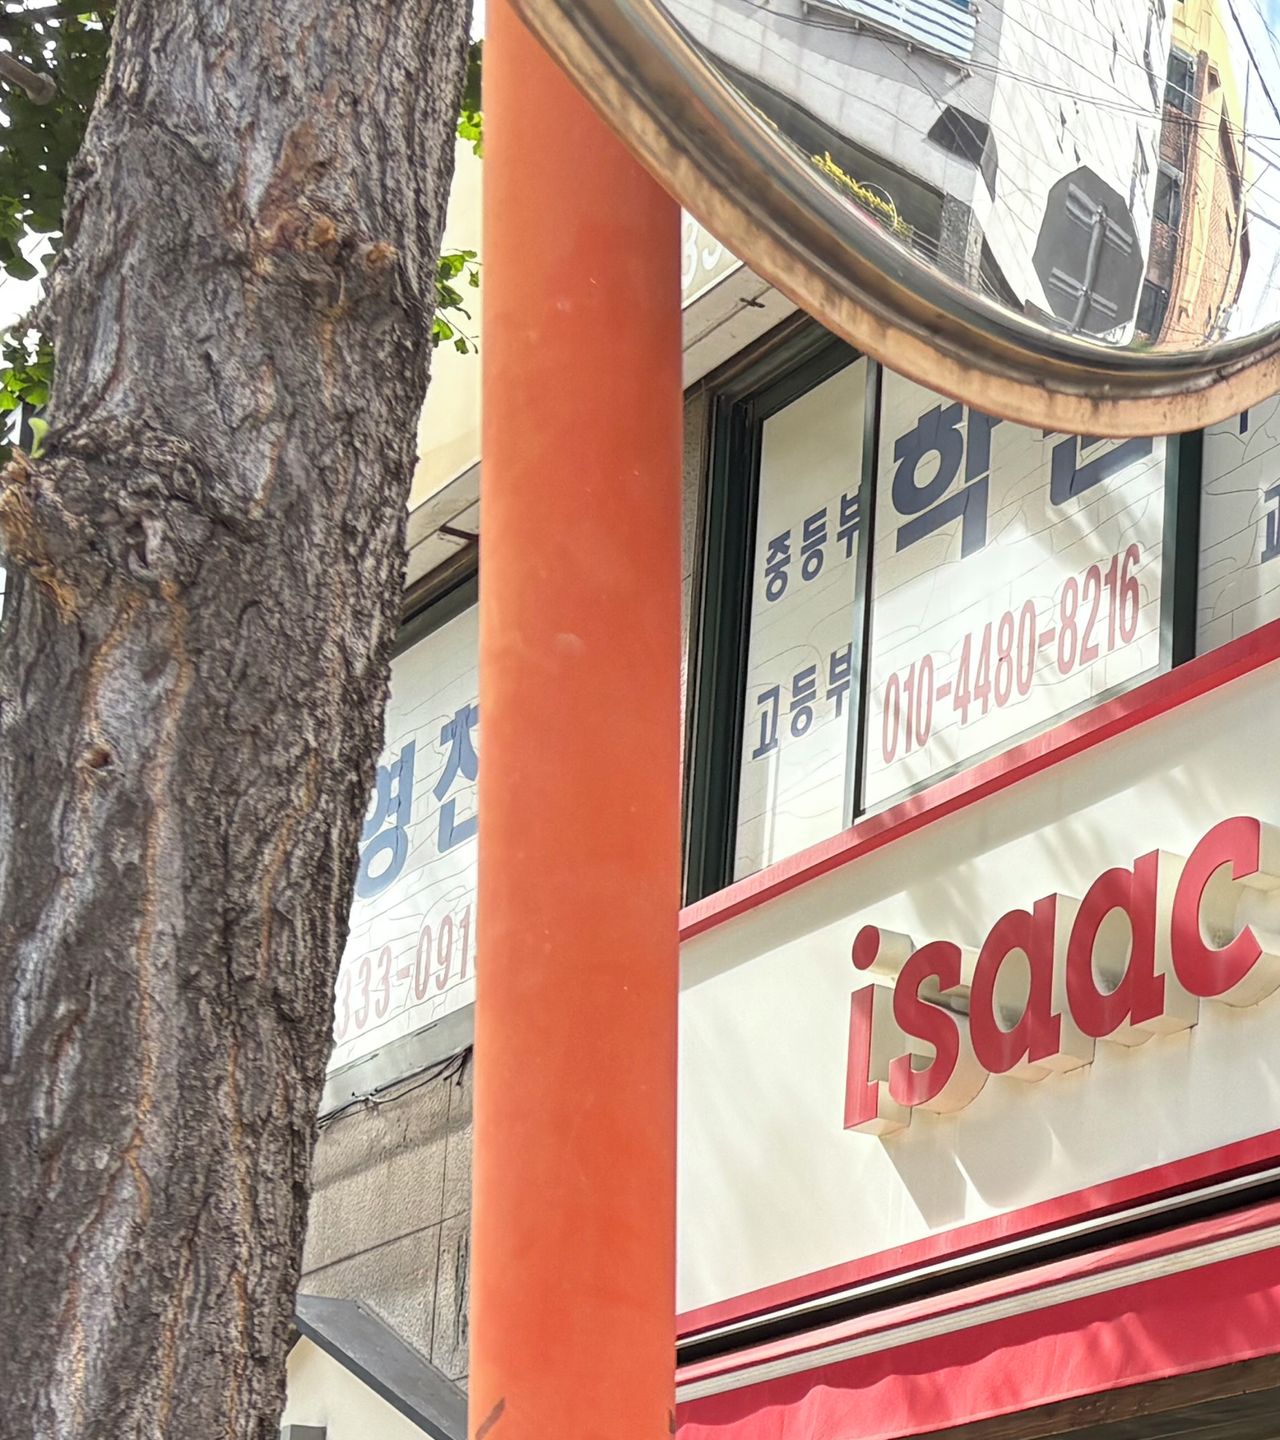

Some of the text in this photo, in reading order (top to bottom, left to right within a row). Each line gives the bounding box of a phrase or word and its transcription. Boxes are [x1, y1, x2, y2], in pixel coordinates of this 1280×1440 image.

[765, 484, 865, 602] 중등부
[752, 642, 853, 761] 고등부
[882, 542, 1141, 766] 010-4480-8216
[843, 815, 1266, 1132] isaac
